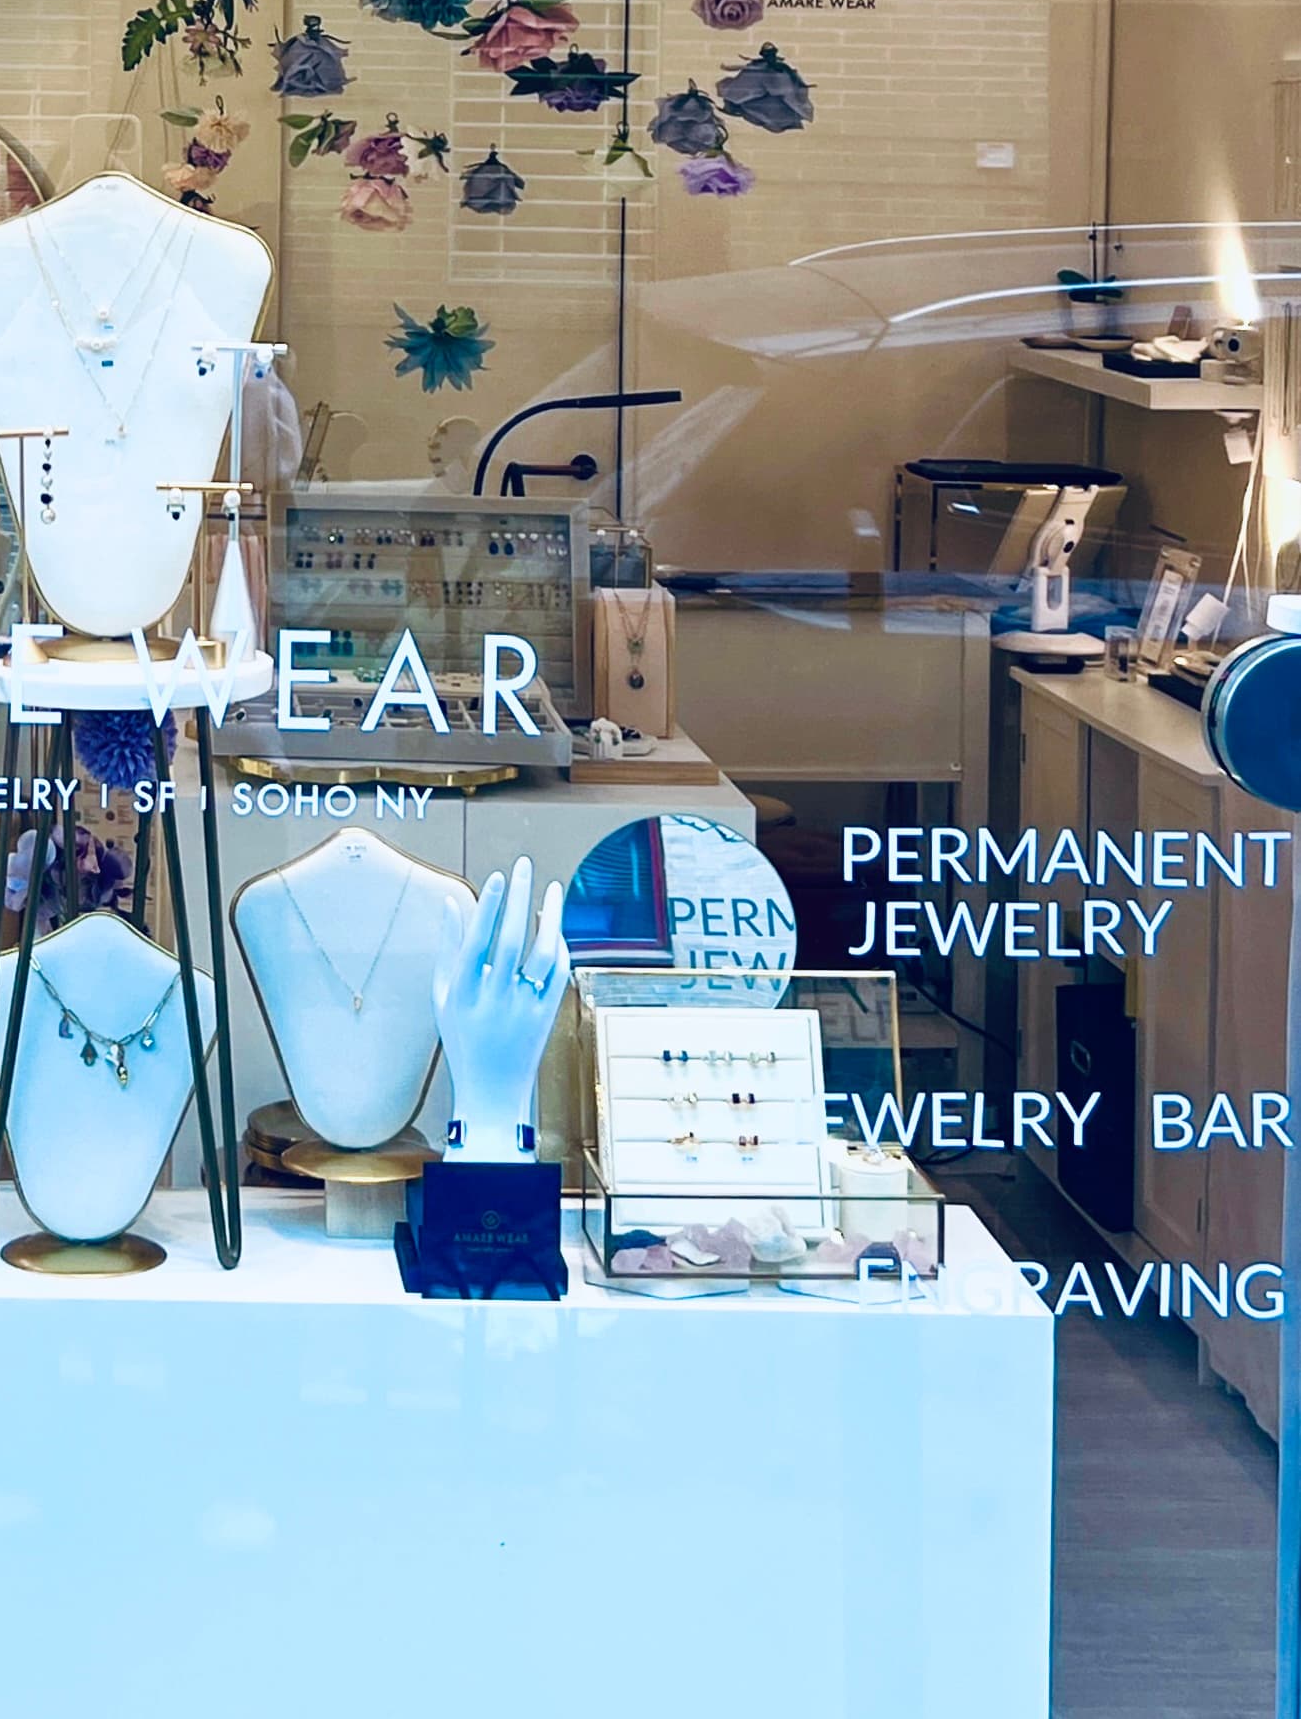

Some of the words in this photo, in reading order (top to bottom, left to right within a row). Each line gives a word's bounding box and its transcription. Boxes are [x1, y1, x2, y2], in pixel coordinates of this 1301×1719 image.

[130, 626, 541, 737] WEAR
[132, 779, 176, 814] SF
[231, 783, 358, 818] SOHO
[375, 785, 433, 819] NY
[842, 826, 1293, 888] PERMANENT
[848, 899, 1174, 957] JEWELRY
[1152, 1092, 1294, 1149] BAR
